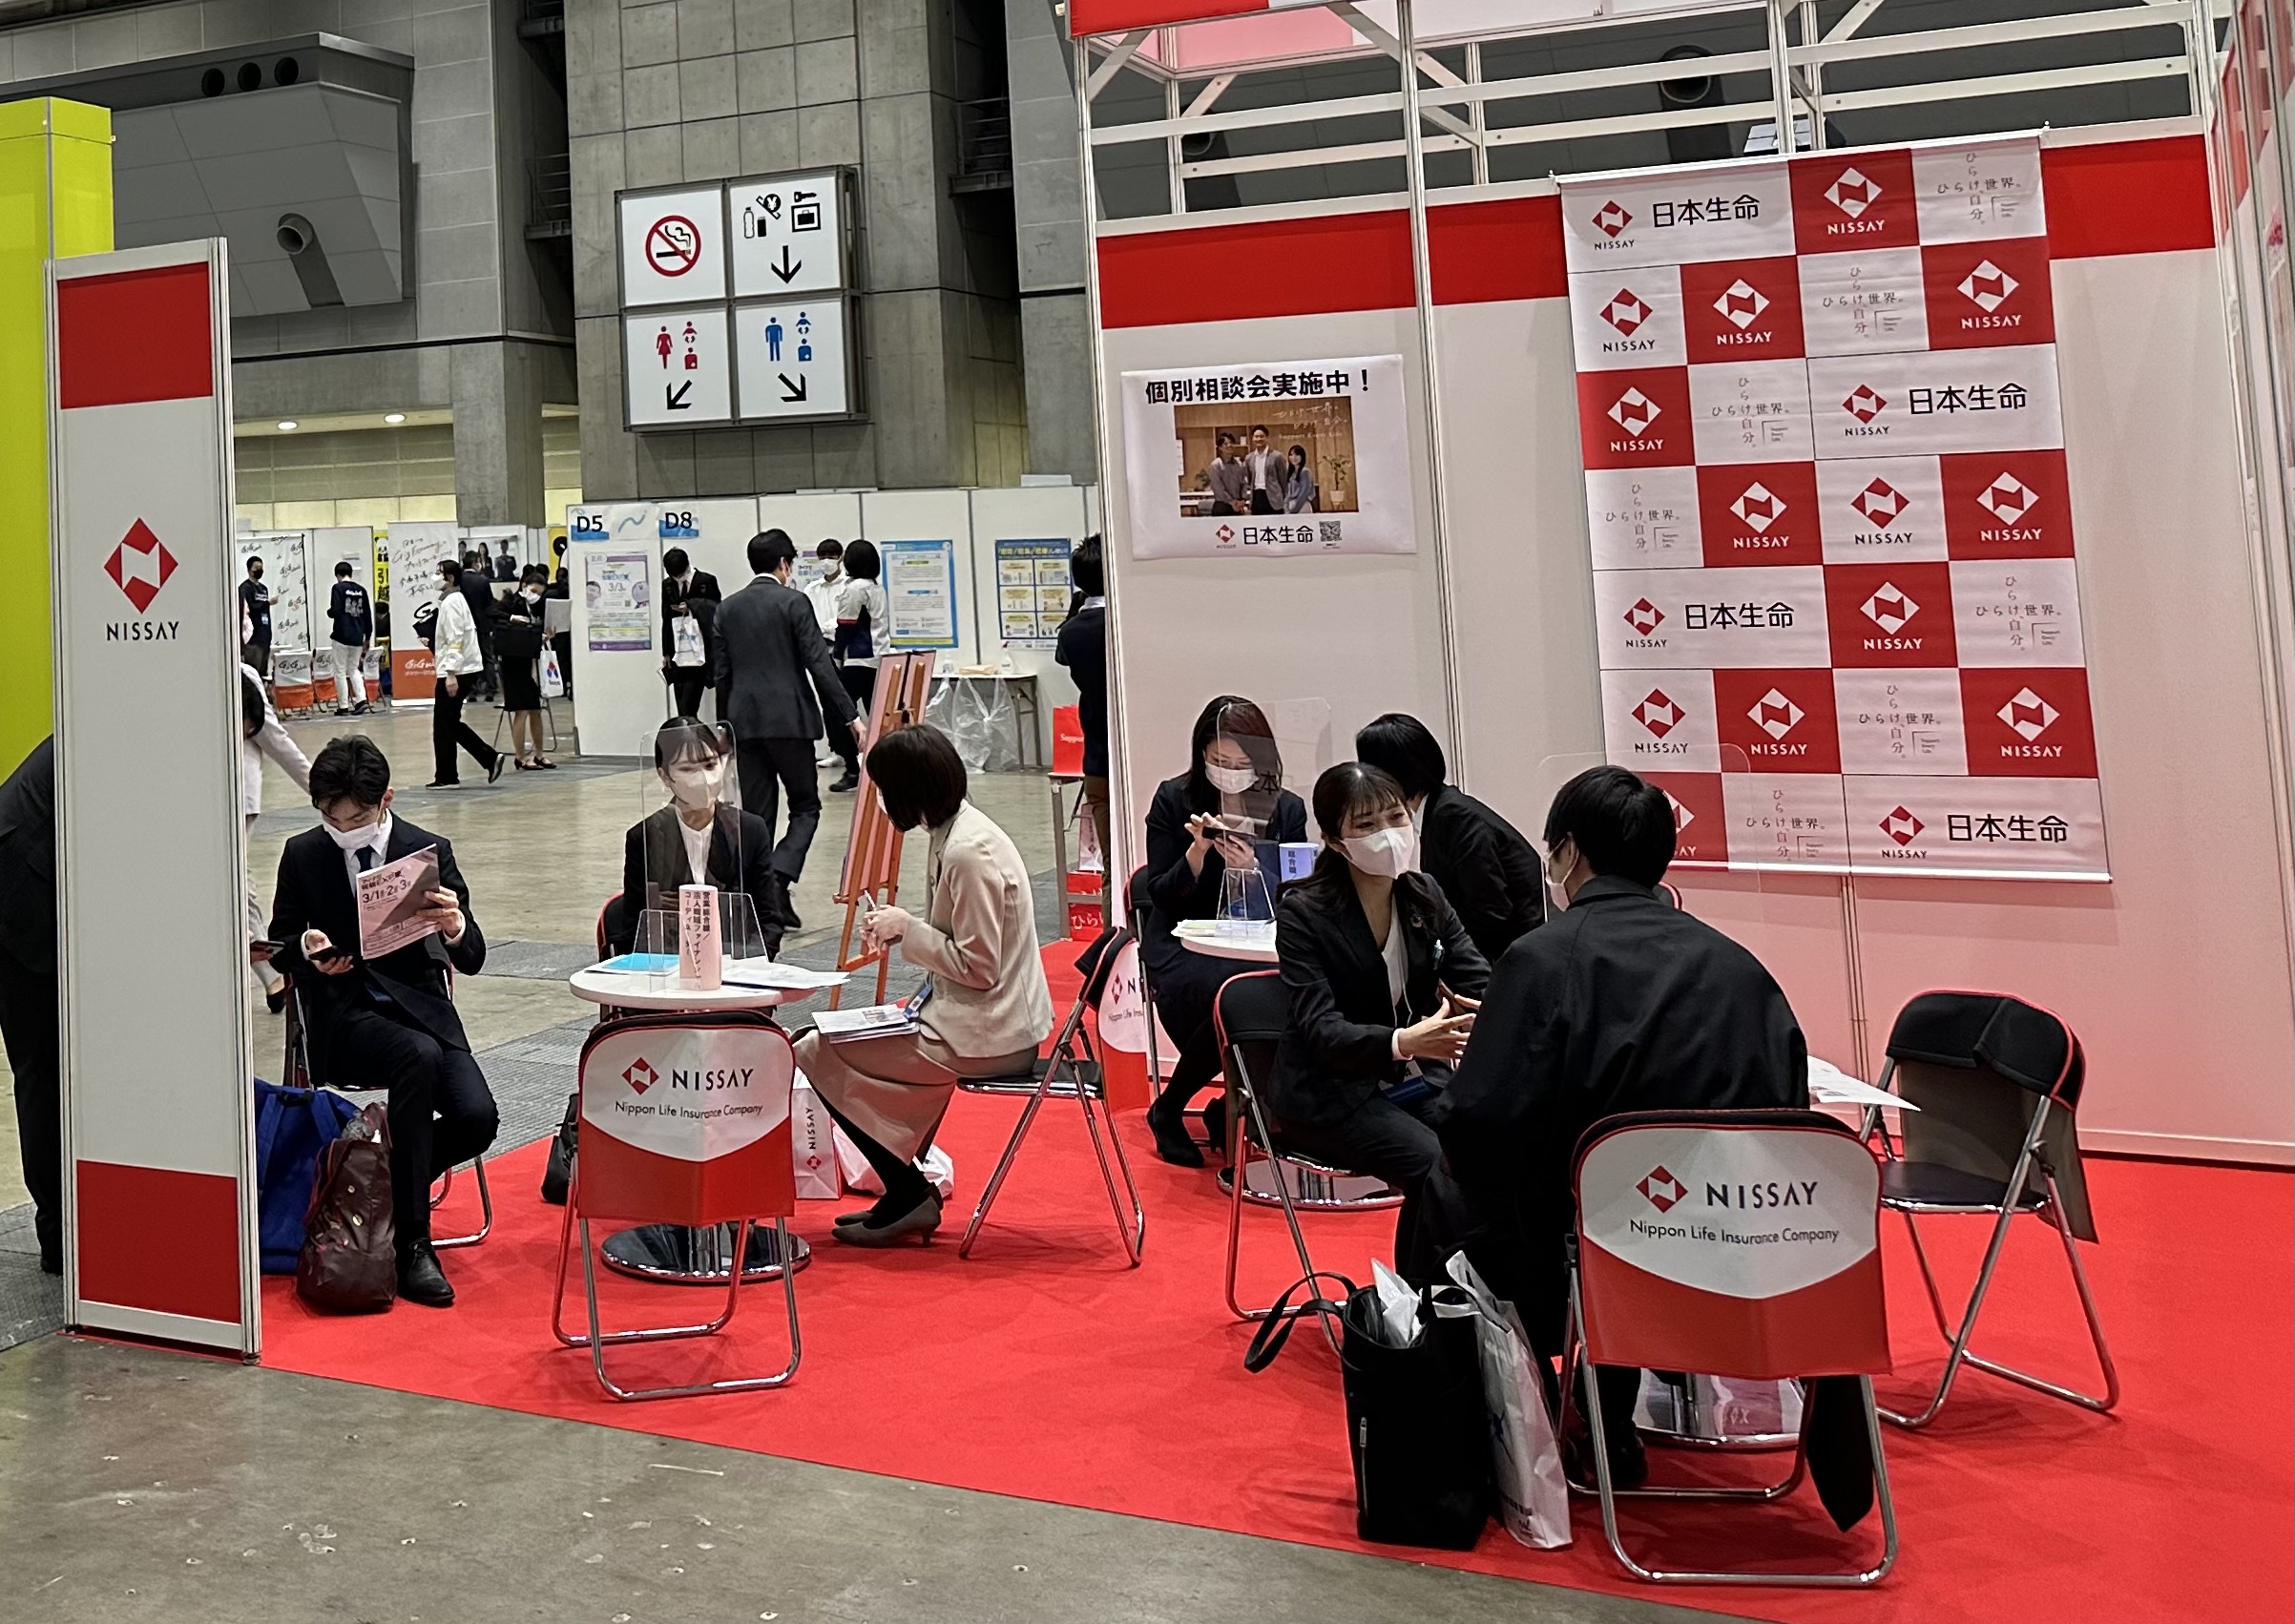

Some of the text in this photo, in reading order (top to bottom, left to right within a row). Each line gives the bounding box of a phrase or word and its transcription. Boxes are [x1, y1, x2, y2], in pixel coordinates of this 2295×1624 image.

[1652, 195, 1760, 228] 日本生命
[1827, 219, 1885, 235] NISSAY
[1594, 239, 1636, 250] NISSAY
[1961, 315, 2021, 330] NISSAY
[1603, 339, 1656, 352] NISSAY
[1717, 331, 1772, 345] NISSAY
[1145, 368, 1368, 404] 個別相談会実施中！
[1909, 383, 2027, 415] 日本生命
[1845, 427, 1889, 437] NISSAY
[1610, 439, 1664, 452] NISSAY
[576, 515, 603, 532] D5
[665, 511, 692, 530] D8
[1243, 525, 1313, 545] 日本生命
[1733, 535, 1790, 550] NISSAY
[1854, 531, 1912, 546] NISSAY
[1980, 529, 2042, 543] NISSAY
[1684, 602, 1794, 630] 日本生命
[106, 621, 179, 641] NISSAY
[1625, 638, 1668, 649] NISSAY
[1864, 637, 1923, 651] NISSAY
[1634, 742, 1688, 754] NISSAY
[1750, 743, 1807, 757] NISSAY
[2000, 744, 2063, 759] NISSAY
[1948, 815, 2069, 843] 日本生命
[1881, 849, 1927, 859] NISSAY
[672, 1068, 754, 1092] NISSAY
[615, 1100, 763, 1119] Nippon Life Insurance Company
[807, 1107, 816, 1150] NISSAY
[1706, 1181, 1818, 1209] NISSAY
[1630, 1219, 1840, 1244] Nippon Life Insurance Company
